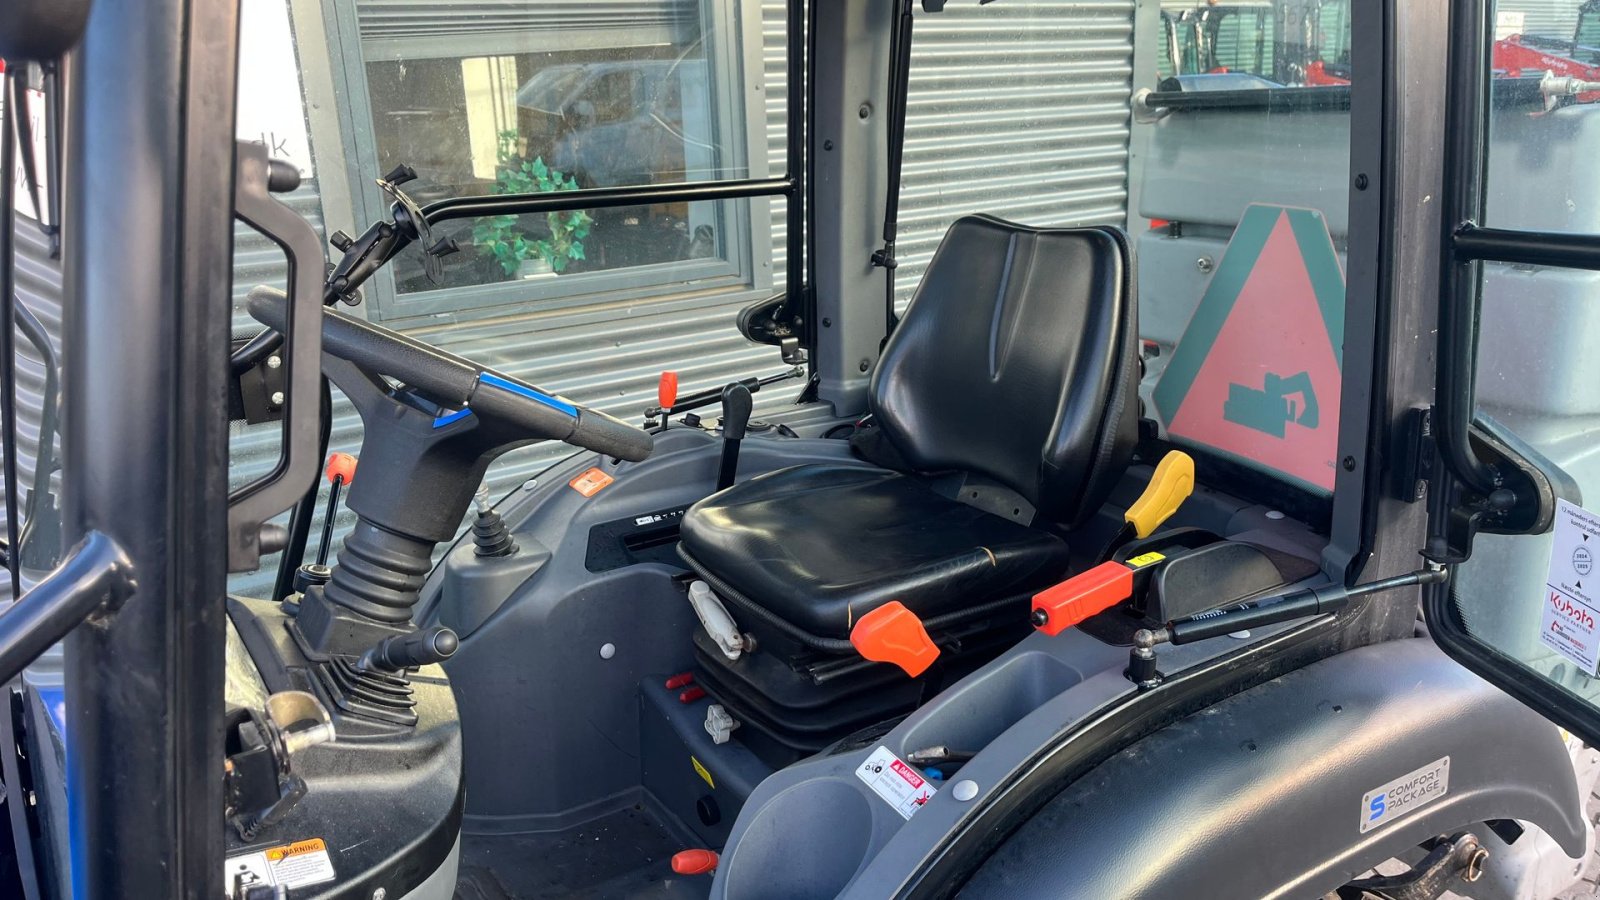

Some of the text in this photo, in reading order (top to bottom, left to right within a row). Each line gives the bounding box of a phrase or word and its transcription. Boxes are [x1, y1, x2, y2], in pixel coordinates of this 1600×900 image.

[1550, 591, 1594, 629] Kubota
[898, 766, 921, 787] DANGER
[1388, 768, 1440, 799] COMFORT
[1388, 779, 1439, 811] PACKAGE
[281, 843, 320, 855] WARNING
